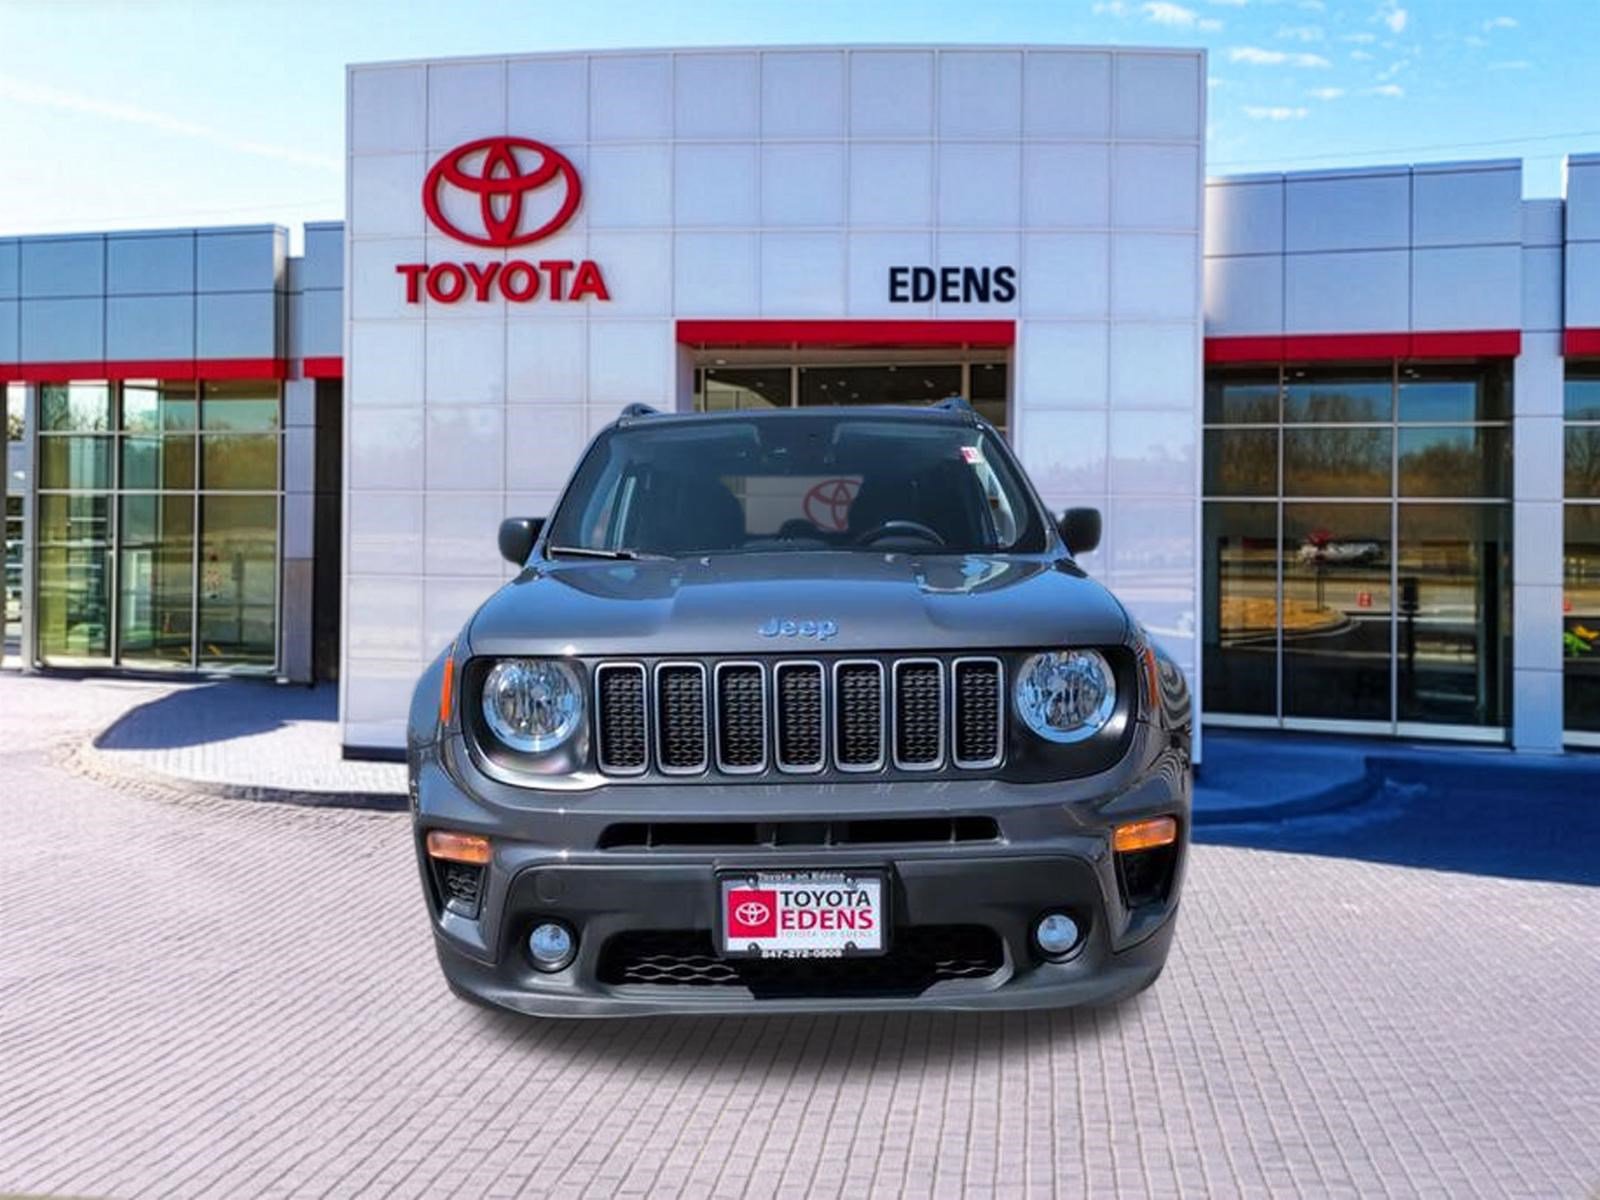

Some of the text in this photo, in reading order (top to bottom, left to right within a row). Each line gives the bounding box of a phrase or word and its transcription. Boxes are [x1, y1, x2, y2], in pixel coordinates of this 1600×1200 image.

[396, 260, 610, 304] TOYOTA
[889, 266, 1016, 303] EDENS
[757, 617, 839, 641] Jeep
[757, 872, 791, 881] Toyota
[812, 872, 845, 881] Edens
[780, 890, 871, 907] TOYOTA
[781, 909, 873, 930] EDENS
